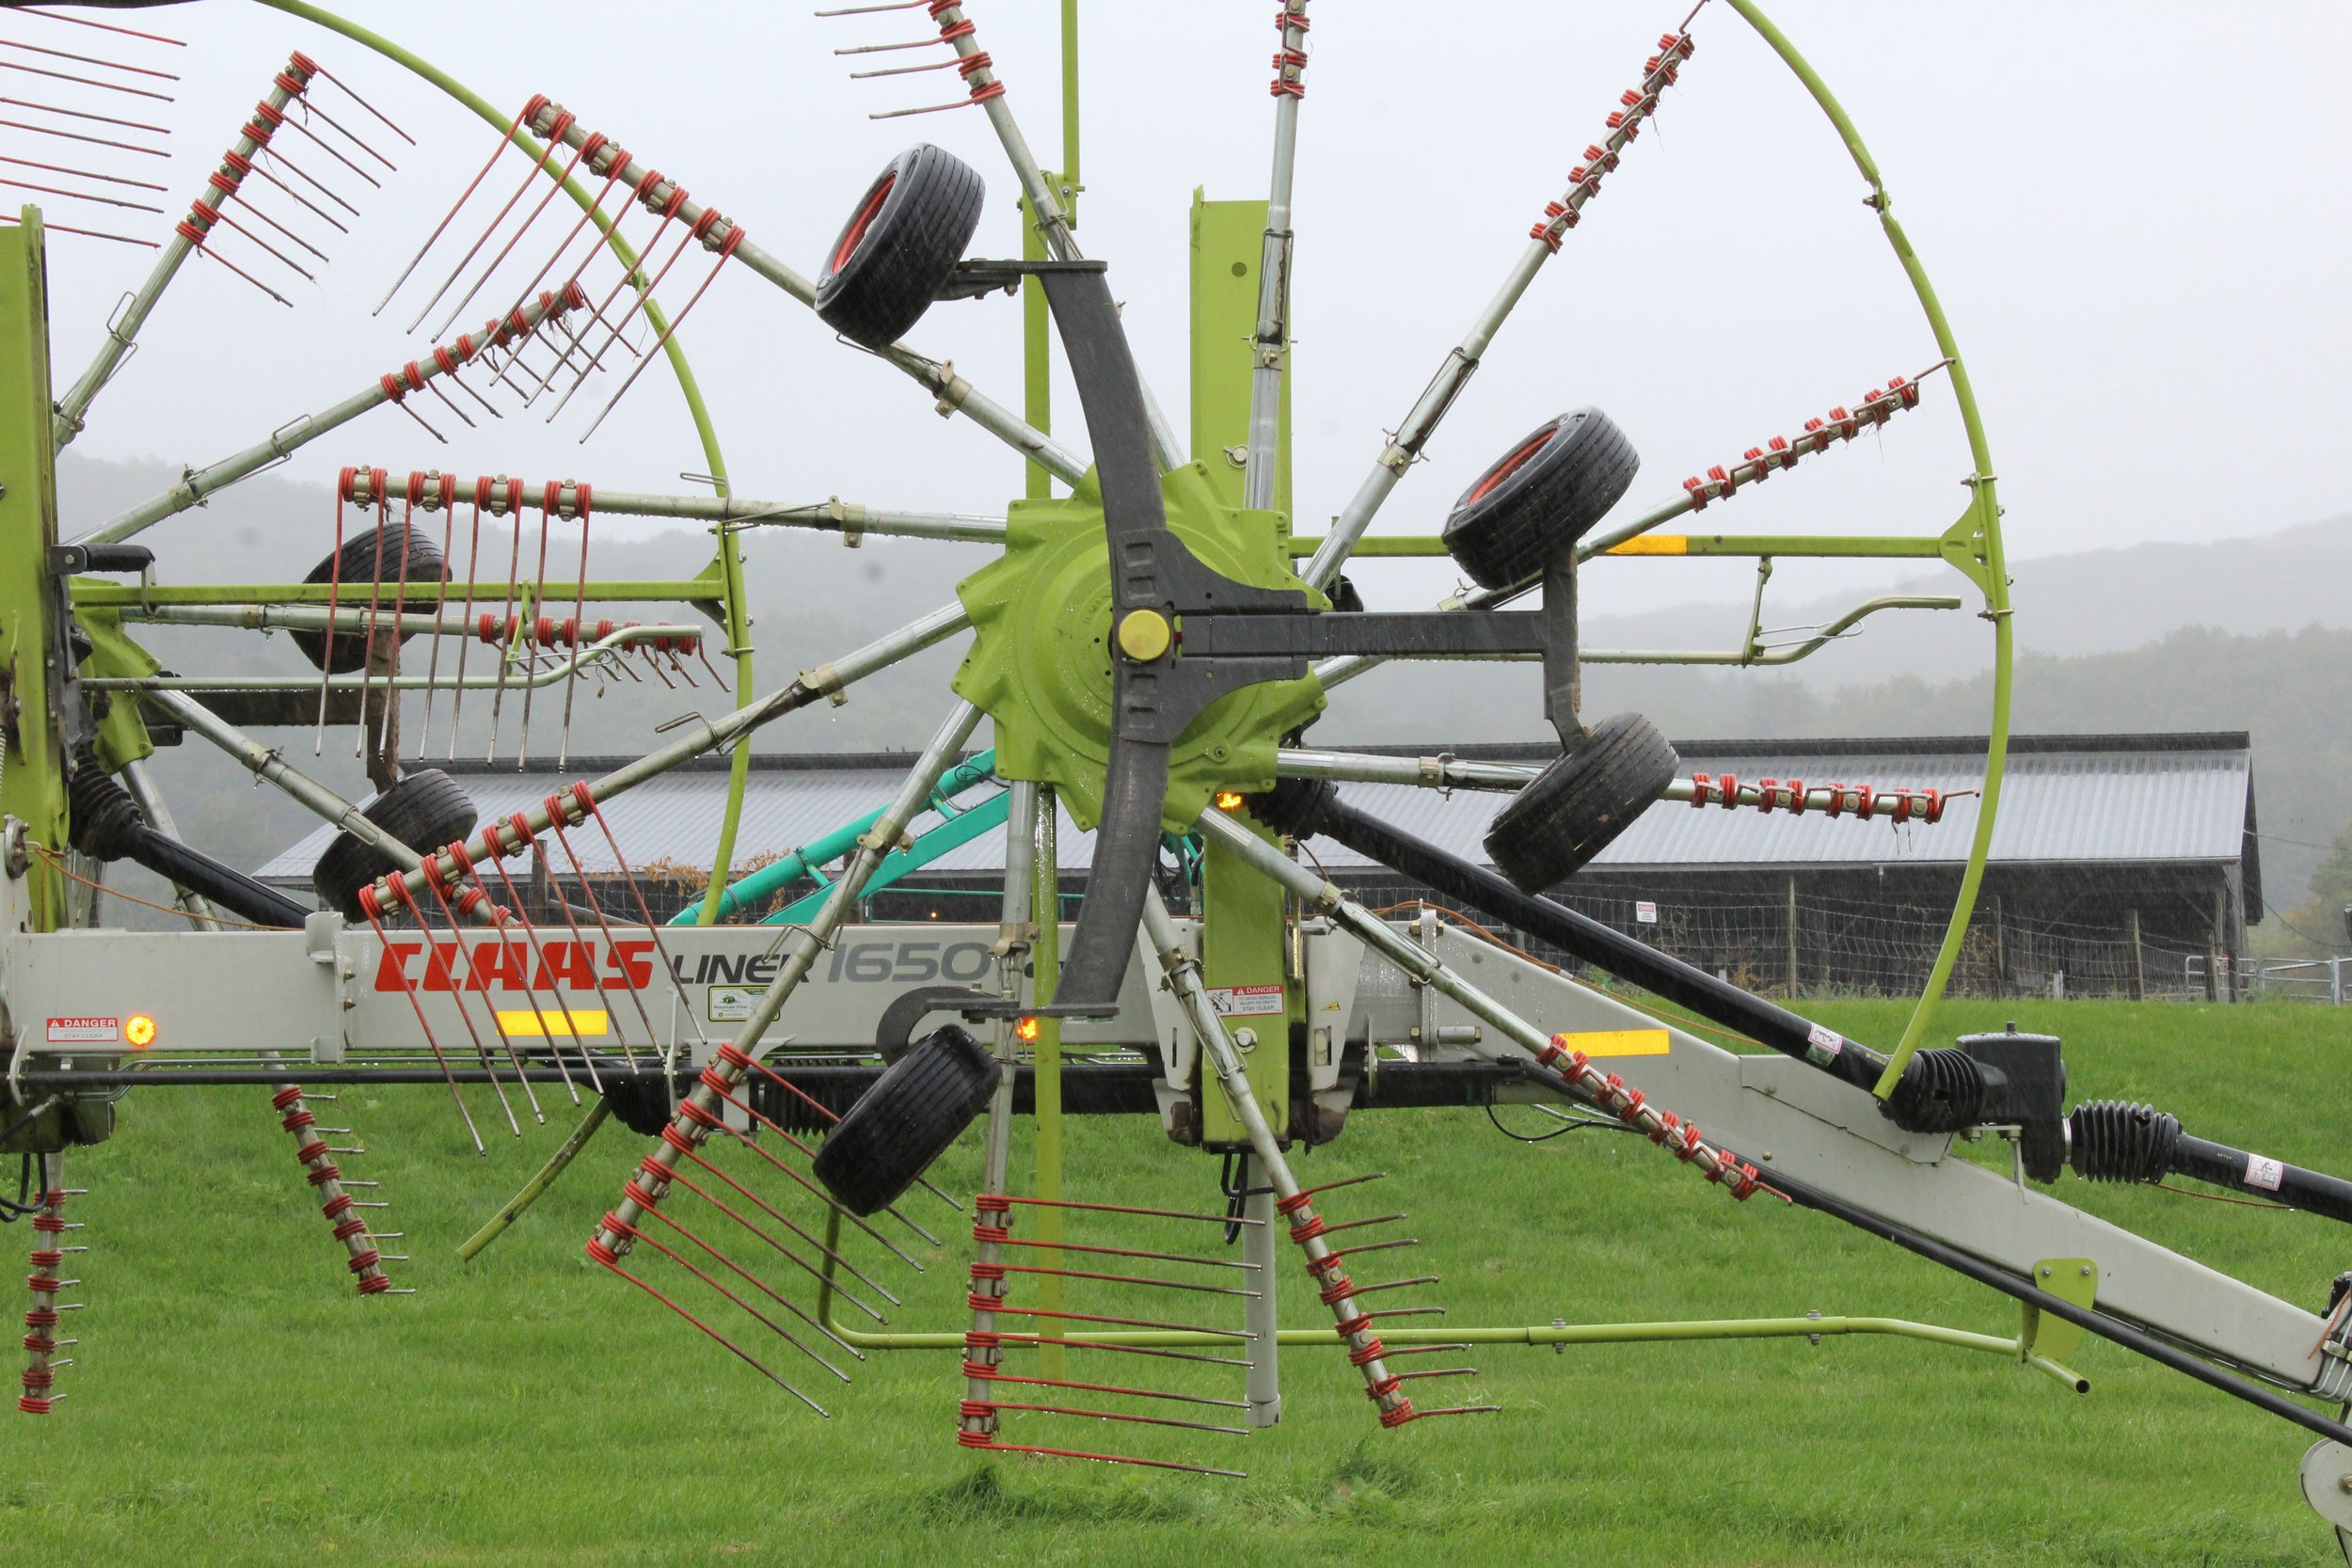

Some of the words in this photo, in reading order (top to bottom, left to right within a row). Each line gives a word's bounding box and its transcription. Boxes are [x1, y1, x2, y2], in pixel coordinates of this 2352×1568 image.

[374, 941, 657, 991] CLAAS
[827, 942, 992, 983] 1650
[1247, 985, 1280, 994] DANGER
[64, 1019, 116, 1027] DANGER
